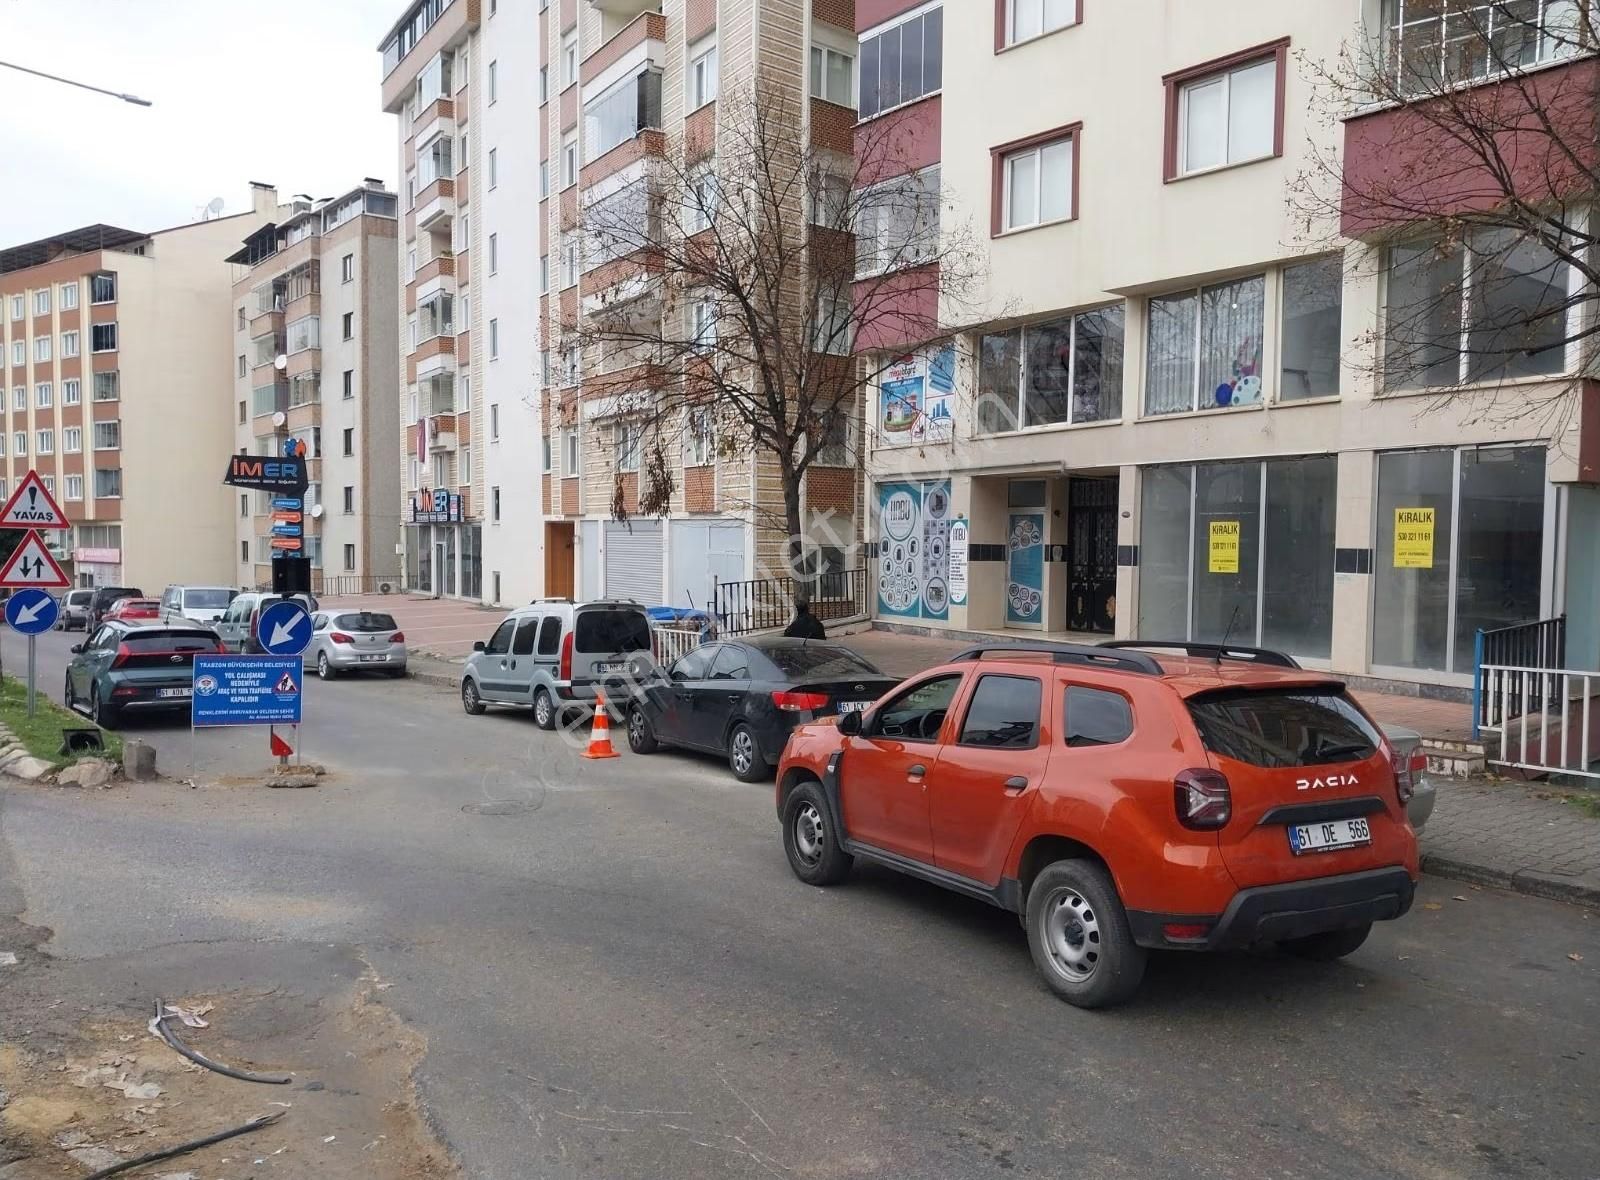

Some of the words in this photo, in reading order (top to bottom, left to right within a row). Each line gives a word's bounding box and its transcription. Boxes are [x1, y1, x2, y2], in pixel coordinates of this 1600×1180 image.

[13, 511, 53, 522] YAVAŞ
[1295, 775, 1359, 790] DACIA
[1297, 827, 1312, 846] 61
[1321, 824, 1338, 843] DE
[1347, 820, 1369, 839] 566
